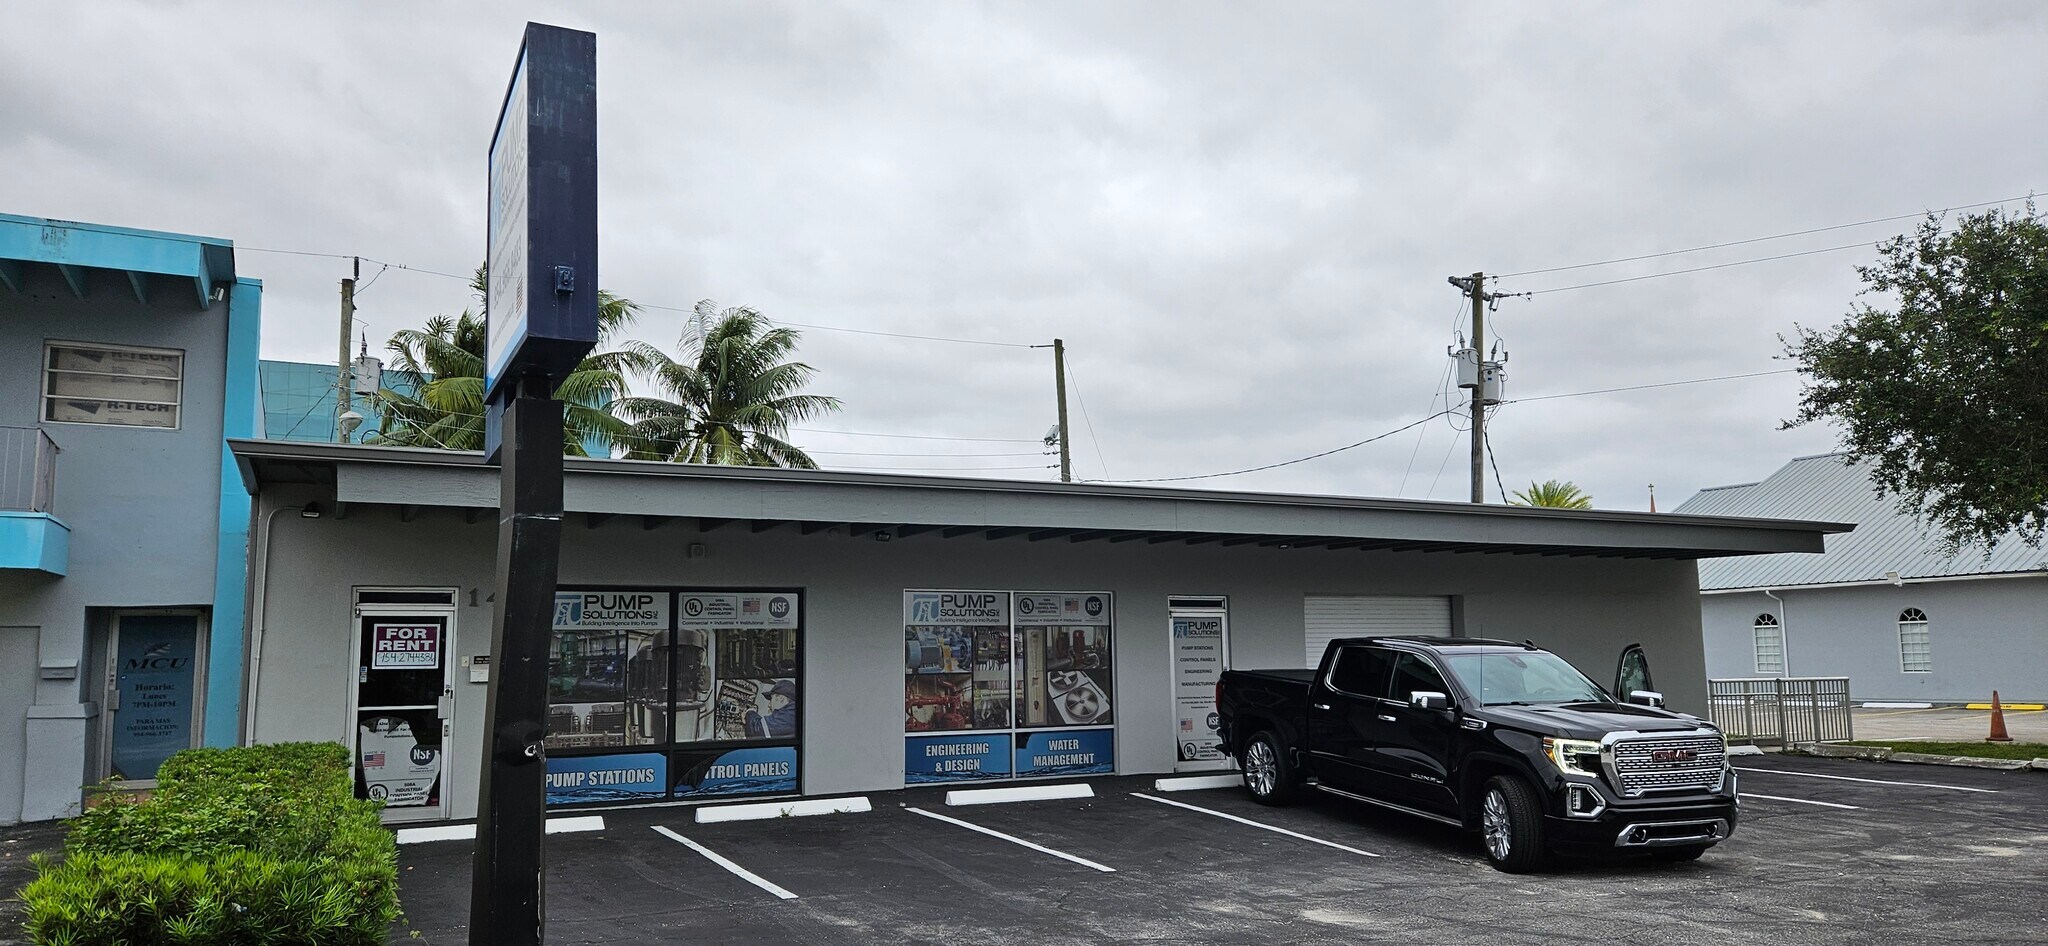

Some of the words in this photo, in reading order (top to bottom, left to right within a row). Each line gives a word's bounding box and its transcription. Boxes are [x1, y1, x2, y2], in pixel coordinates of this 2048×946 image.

[107, 401, 169, 412] R-TECH
[583, 595, 654, 610] PUMP
[941, 594, 996, 608] PUMP
[1087, 601, 1101, 611] NSF
[771, 602, 787, 613] NSF
[940, 608, 996, 617] SOLUTIONS
[582, 610, 653, 620] SOLUTIONS
[1188, 621, 1218, 630] PUMP
[386, 628, 427, 639] FOR
[379, 640, 434, 651] RENT
[125, 658, 188, 670] MCU
[925, 742, 990, 757] ENGINEERING
[1048, 739, 1079, 751] WATER
[413, 749, 431, 760] NSF
[1033, 753, 1095, 767] MANAGEMENT
[1652, 749, 1698, 761] GMC
[744, 761, 789, 777] PANELS
[935, 762, 943, 772] &
[945, 759, 981, 771] DESIGN
[545, 772, 586, 788] PUMP
[588, 768, 655, 785] STATIONS
